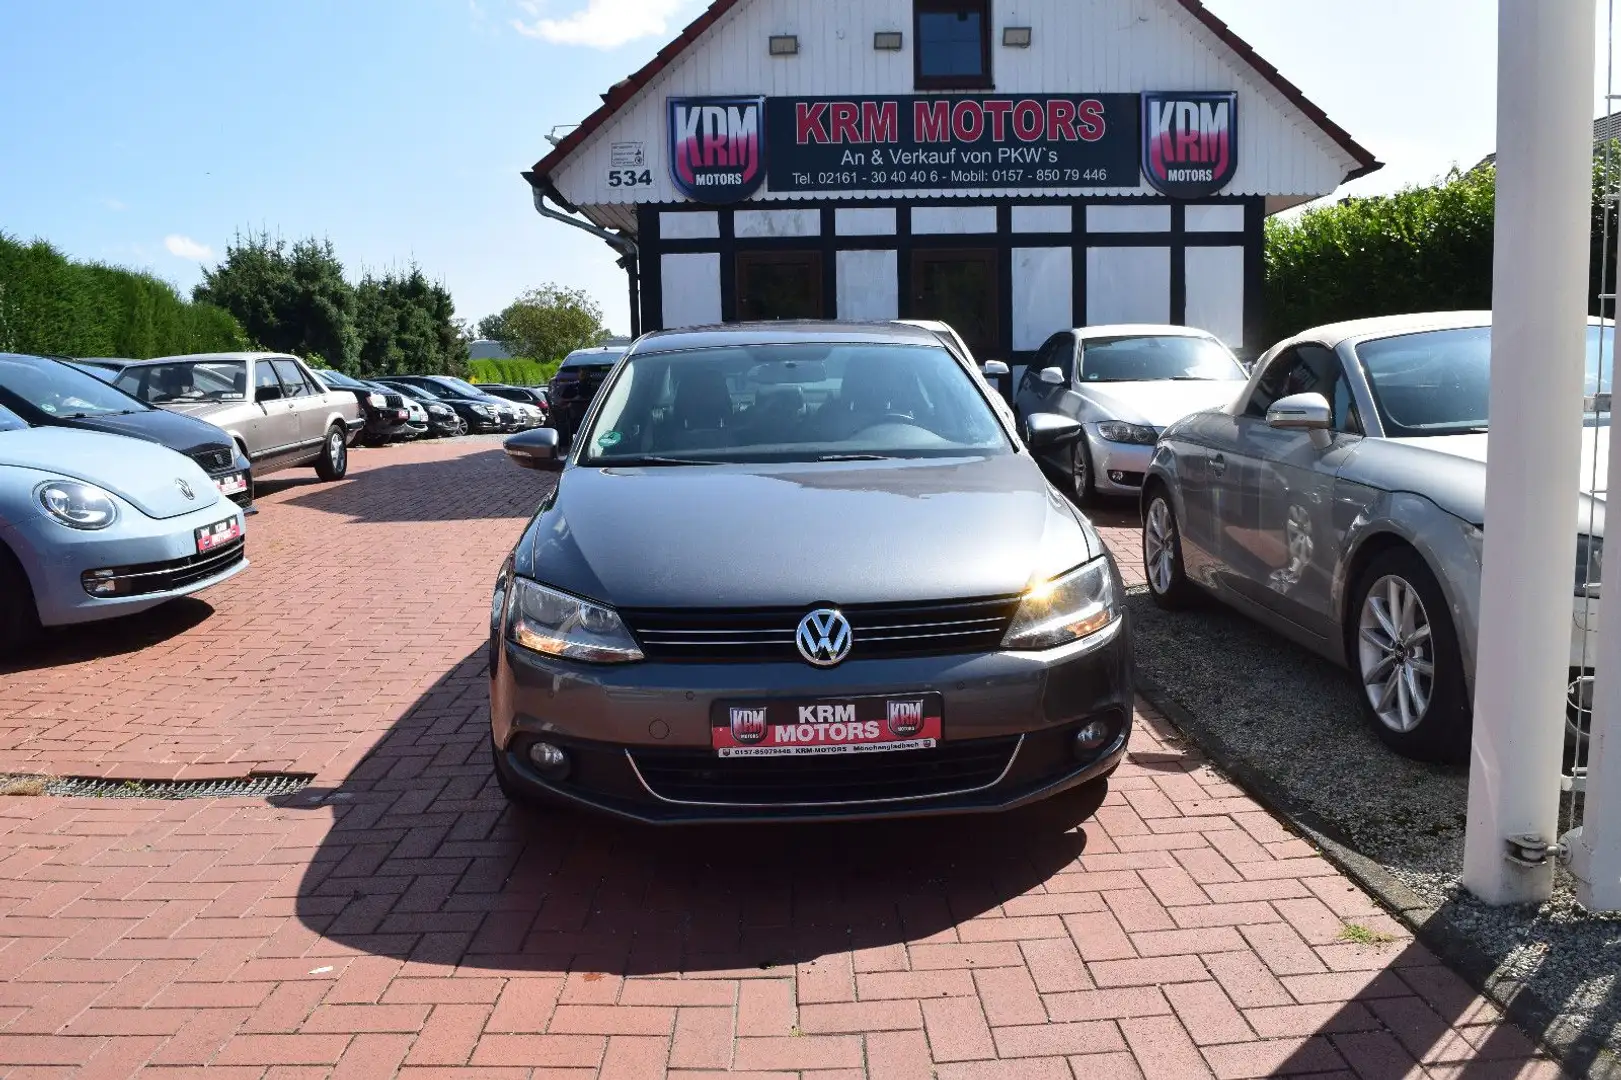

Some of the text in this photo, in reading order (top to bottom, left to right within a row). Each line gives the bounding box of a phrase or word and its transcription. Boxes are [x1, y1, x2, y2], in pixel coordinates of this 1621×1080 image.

[796, 100, 1105, 144] KRM MOTORS
[675, 106, 758, 184] KRM
[1150, 101, 1228, 180] KRM
[841, 149, 865, 165] An
[871, 149, 884, 165] &
[889, 147, 956, 165] Verkauf
[961, 151, 992, 164] von
[608, 169, 653, 187] 534
[695, 173, 742, 186] MOTORS
[792, 172, 814, 185] Tel.
[818, 172, 857, 184] 02161
[871, 171, 887, 184] 30
[890, 171, 906, 183] 40
[910, 170, 926, 183] 40
[930, 170, 939, 183] 6
[951, 169, 989, 182] Mobil:
[992, 169, 1024, 182] 0157
[1036, 169, 1060, 181] 850
[1064, 168, 1080, 181] 79
[1083, 168, 1107, 181] 446
[1167, 169, 1213, 182] MOTORS
[798, 704, 856, 723] KRM
[775, 720, 880, 742] MOTORS
